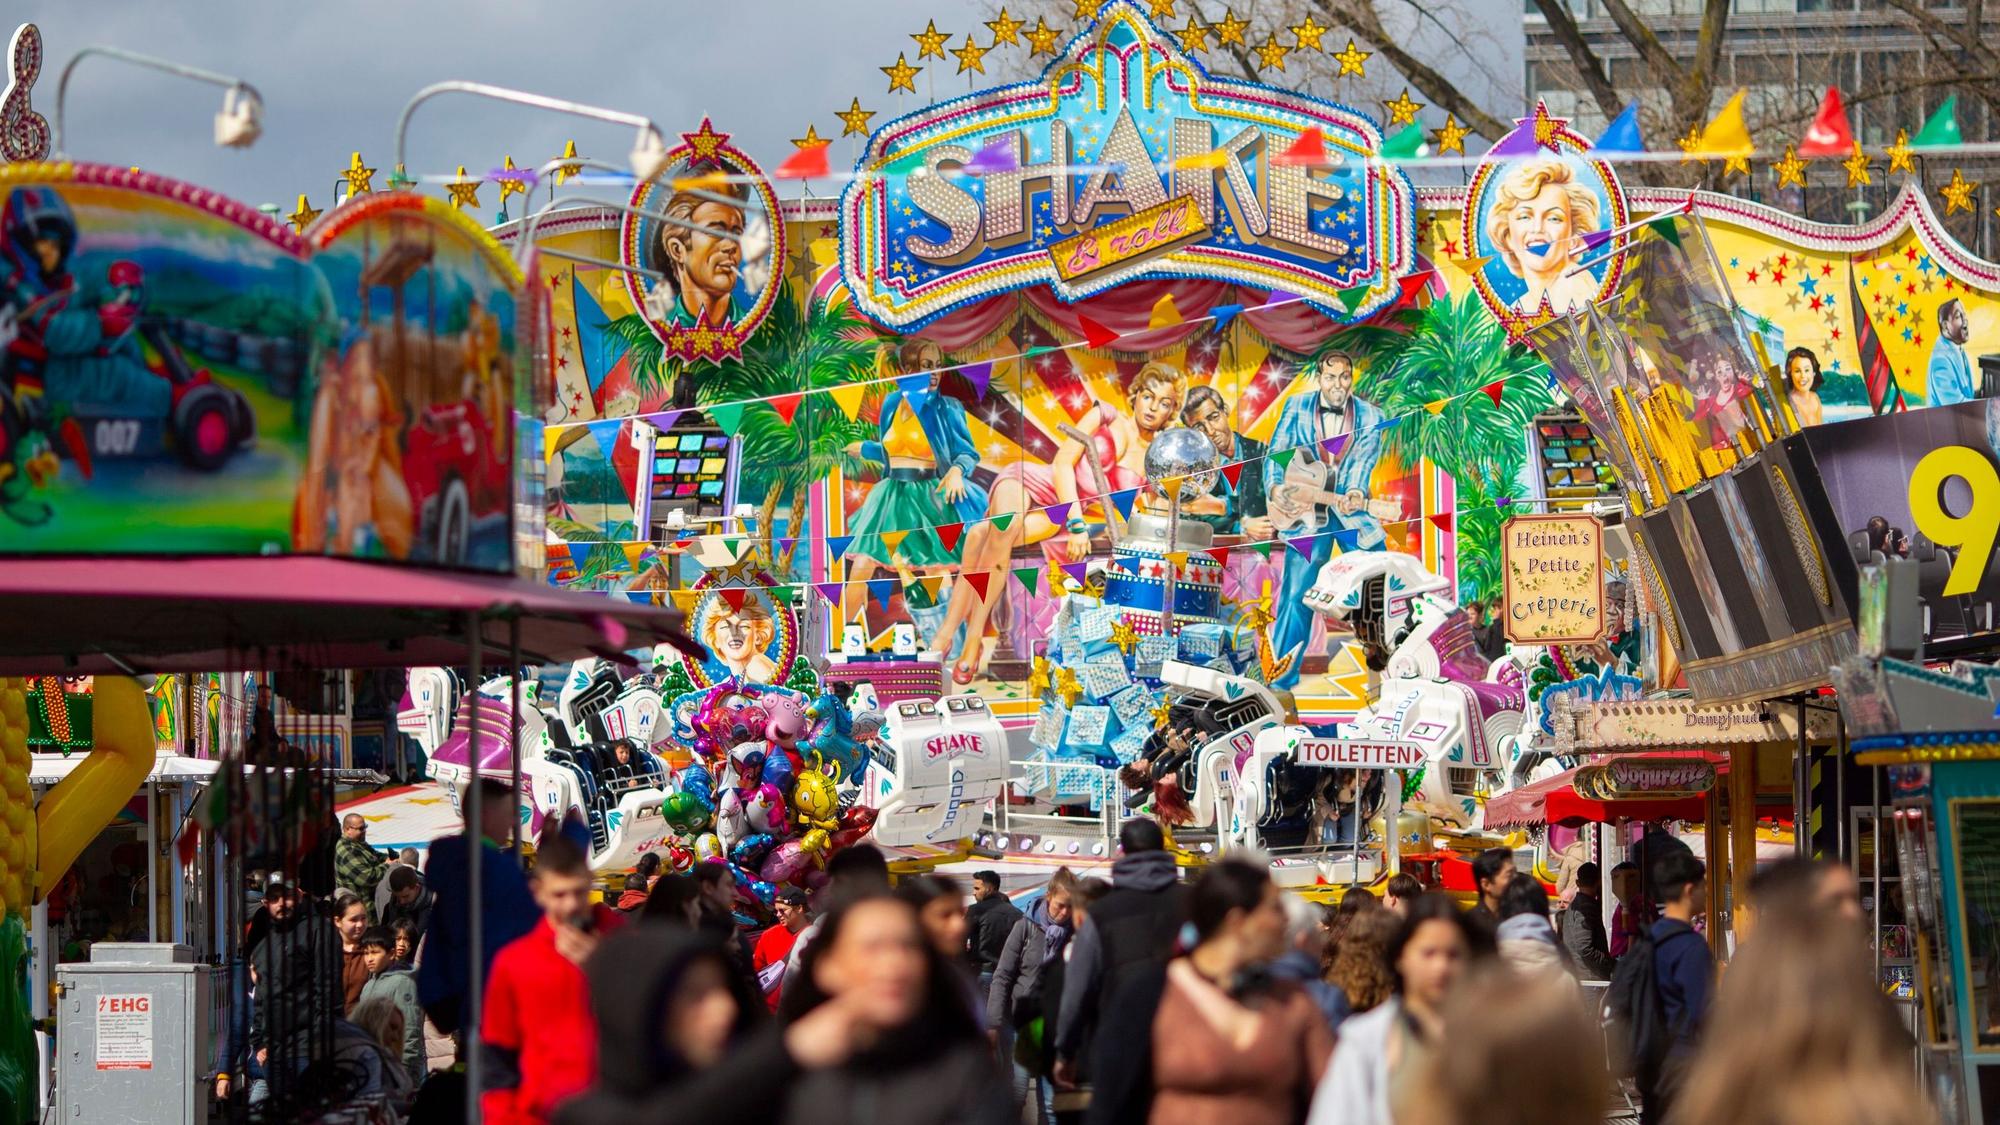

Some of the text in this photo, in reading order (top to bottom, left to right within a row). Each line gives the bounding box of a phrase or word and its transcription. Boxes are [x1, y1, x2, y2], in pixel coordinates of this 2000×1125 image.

[905, 102, 1350, 259] SHAKE
[1067, 203, 1188, 273] & roll
[96, 420, 140, 454] 007
[1909, 445, 2000, 597] 9
[1516, 531, 1592, 548] Heinen's
[1528, 557, 1582, 574] Petite
[1512, 596, 1596, 620] Crêperie
[1684, 712, 1781, 731] Dampfnudn
[927, 734, 983, 758] SHAKE
[1303, 743, 1411, 763] TOILETTEN
[1615, 763, 1708, 790] Yogurette
[110, 997, 149, 1012] EHG
